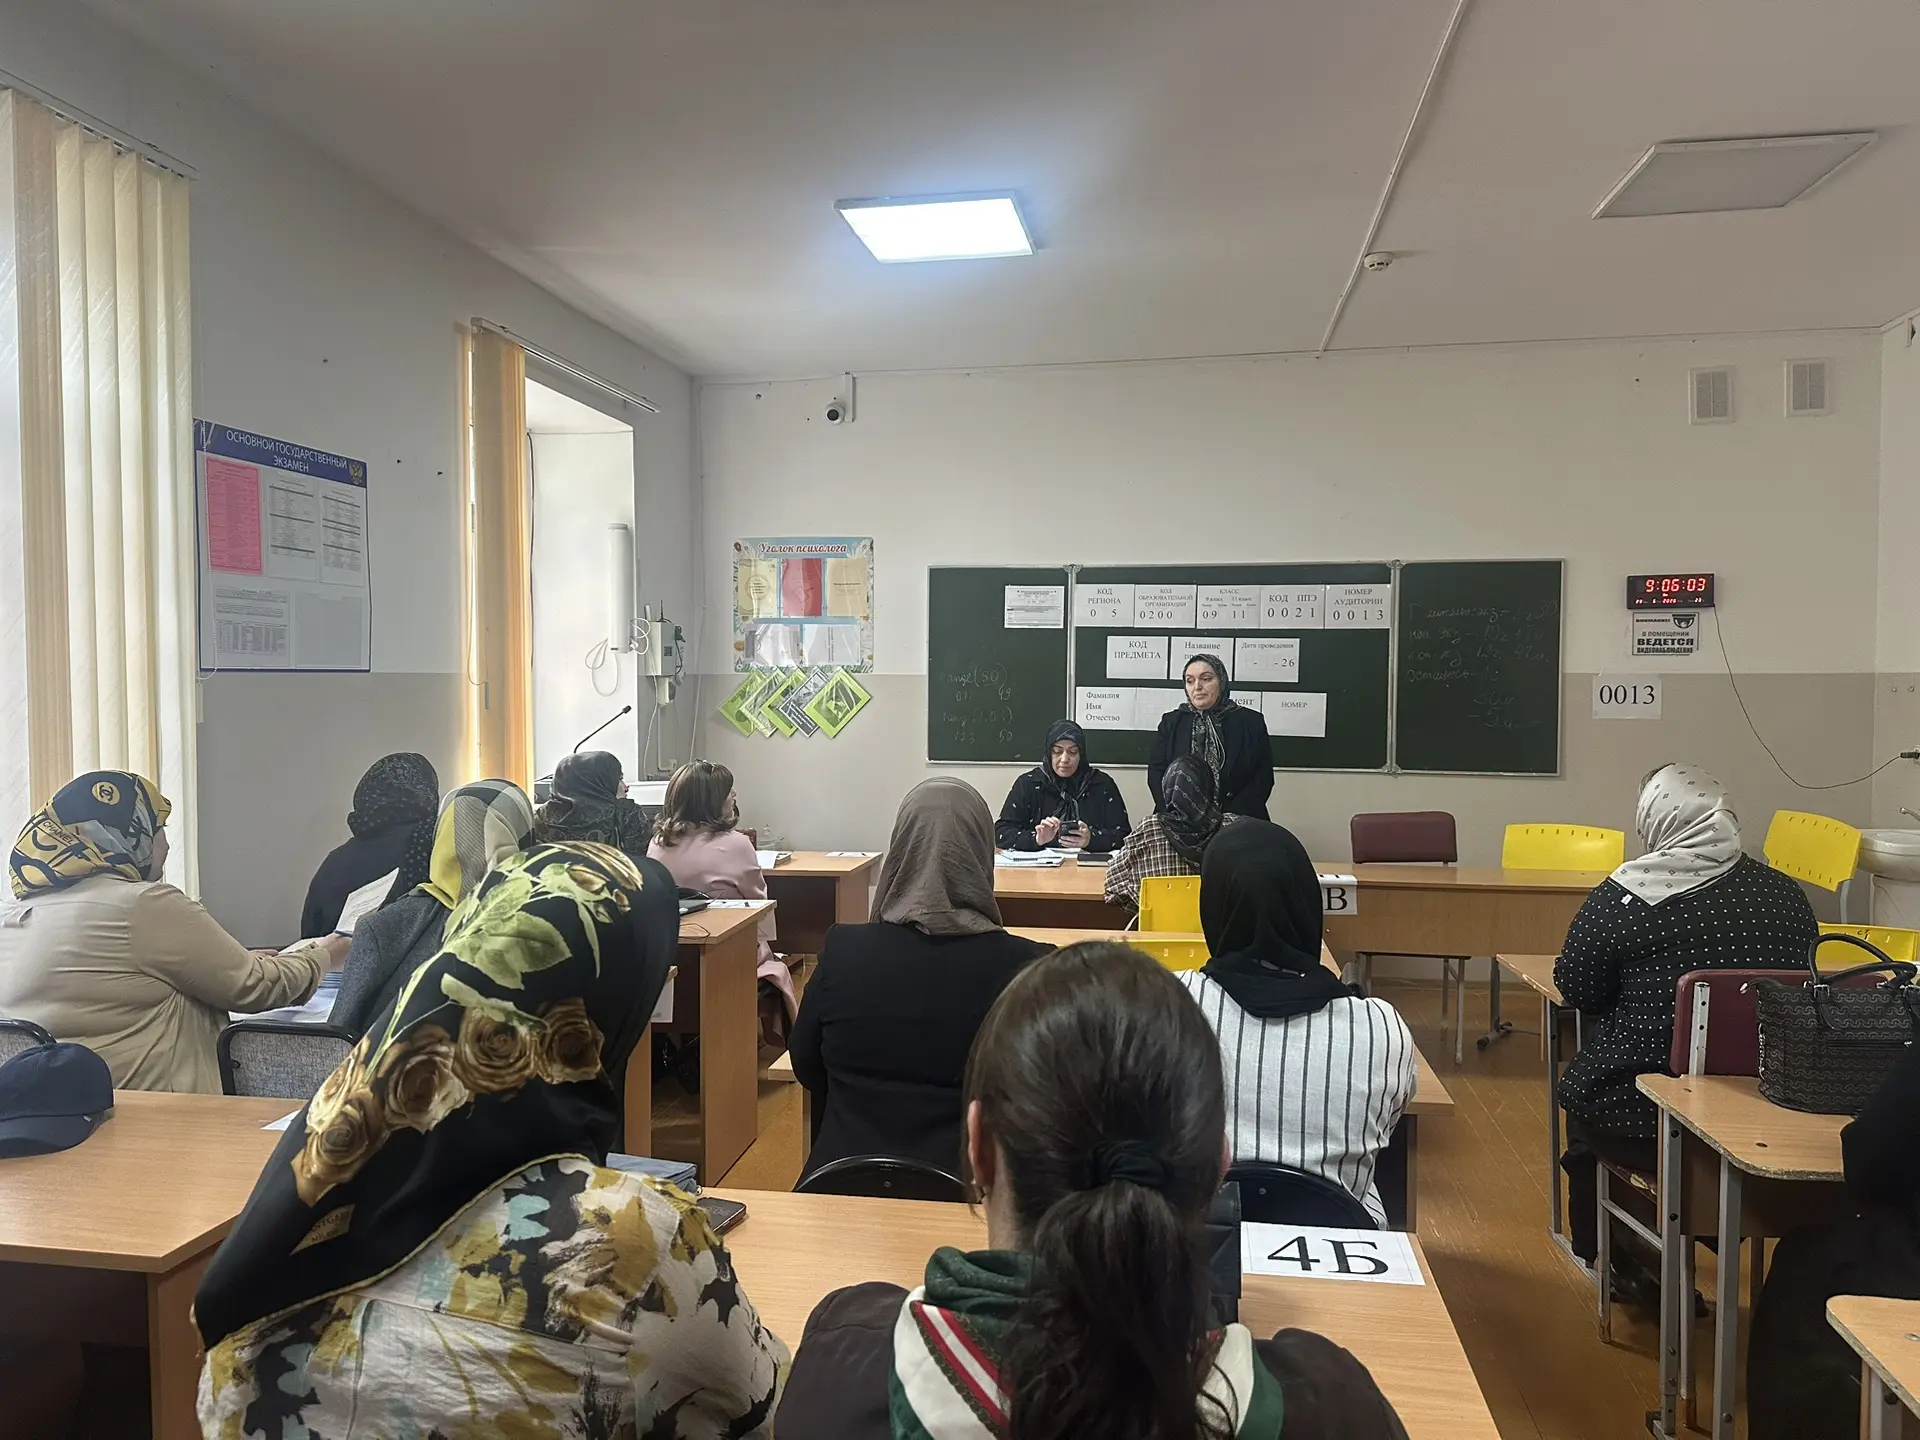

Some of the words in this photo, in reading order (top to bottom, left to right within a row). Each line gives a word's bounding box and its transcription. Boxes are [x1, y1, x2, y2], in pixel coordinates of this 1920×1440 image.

[226, 430, 275, 451] ОСНОВНОЙ
[275, 442, 348, 470] ГОСУДАРСТВЕННЫЙ
[273, 455, 310, 473] ЭКЗАМЕН
[759, 543, 795, 553] Уголок
[796, 544, 847, 553] психолога
[1645, 578, 1706, 593] 9:06:03
[1097, 588, 1113, 596] КОД
[1344, 588, 1373, 596] НОМЕР
[1087, 597, 1122, 605] РЕГИОНА
[1268, 594, 1289, 603] КОД
[1297, 594, 1318, 603] ППЭ
[1334, 598, 1383, 606] АУДИТОРИИ
[1128, 640, 1148, 649] КОД
[1184, 641, 1221, 650] Название
[1241, 642, 1256, 650] Дата
[1637, 638, 1694, 647] ВЕДЕТСЯ
[1114, 651, 1161, 660] ПРЕДМЕТА
[1086, 692, 1120, 700] Фамилия
[1599, 684, 1655, 705] 0013
[1281, 701, 1308, 709] НОМЕР
[1085, 713, 1120, 722] Отчество
[43, 821, 77, 845] CHANEL
[1267, 1235, 1389, 1275] 4Б
